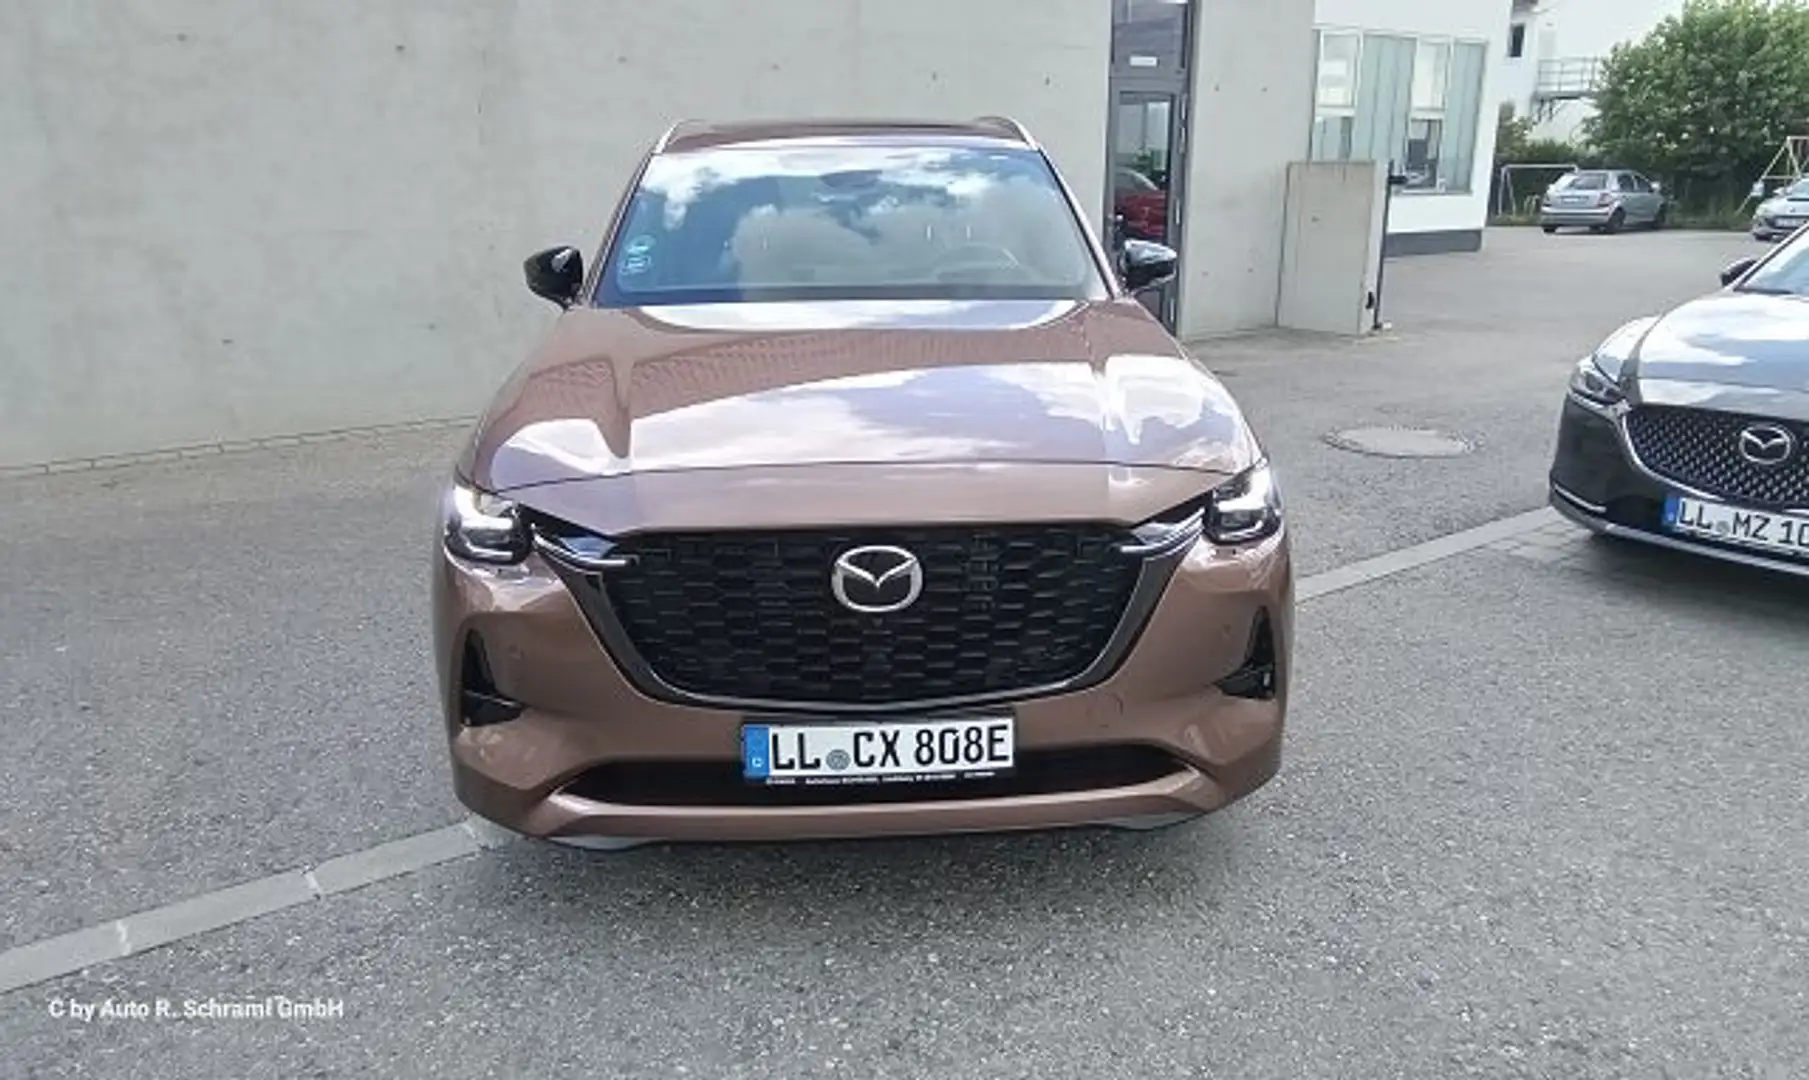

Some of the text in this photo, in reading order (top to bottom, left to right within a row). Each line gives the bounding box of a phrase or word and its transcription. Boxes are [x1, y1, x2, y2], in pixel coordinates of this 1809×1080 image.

[1680, 501, 1713, 529] LL
[1732, 512, 1770, 541] MZ
[771, 724, 1010, 770] LL CX 808E
